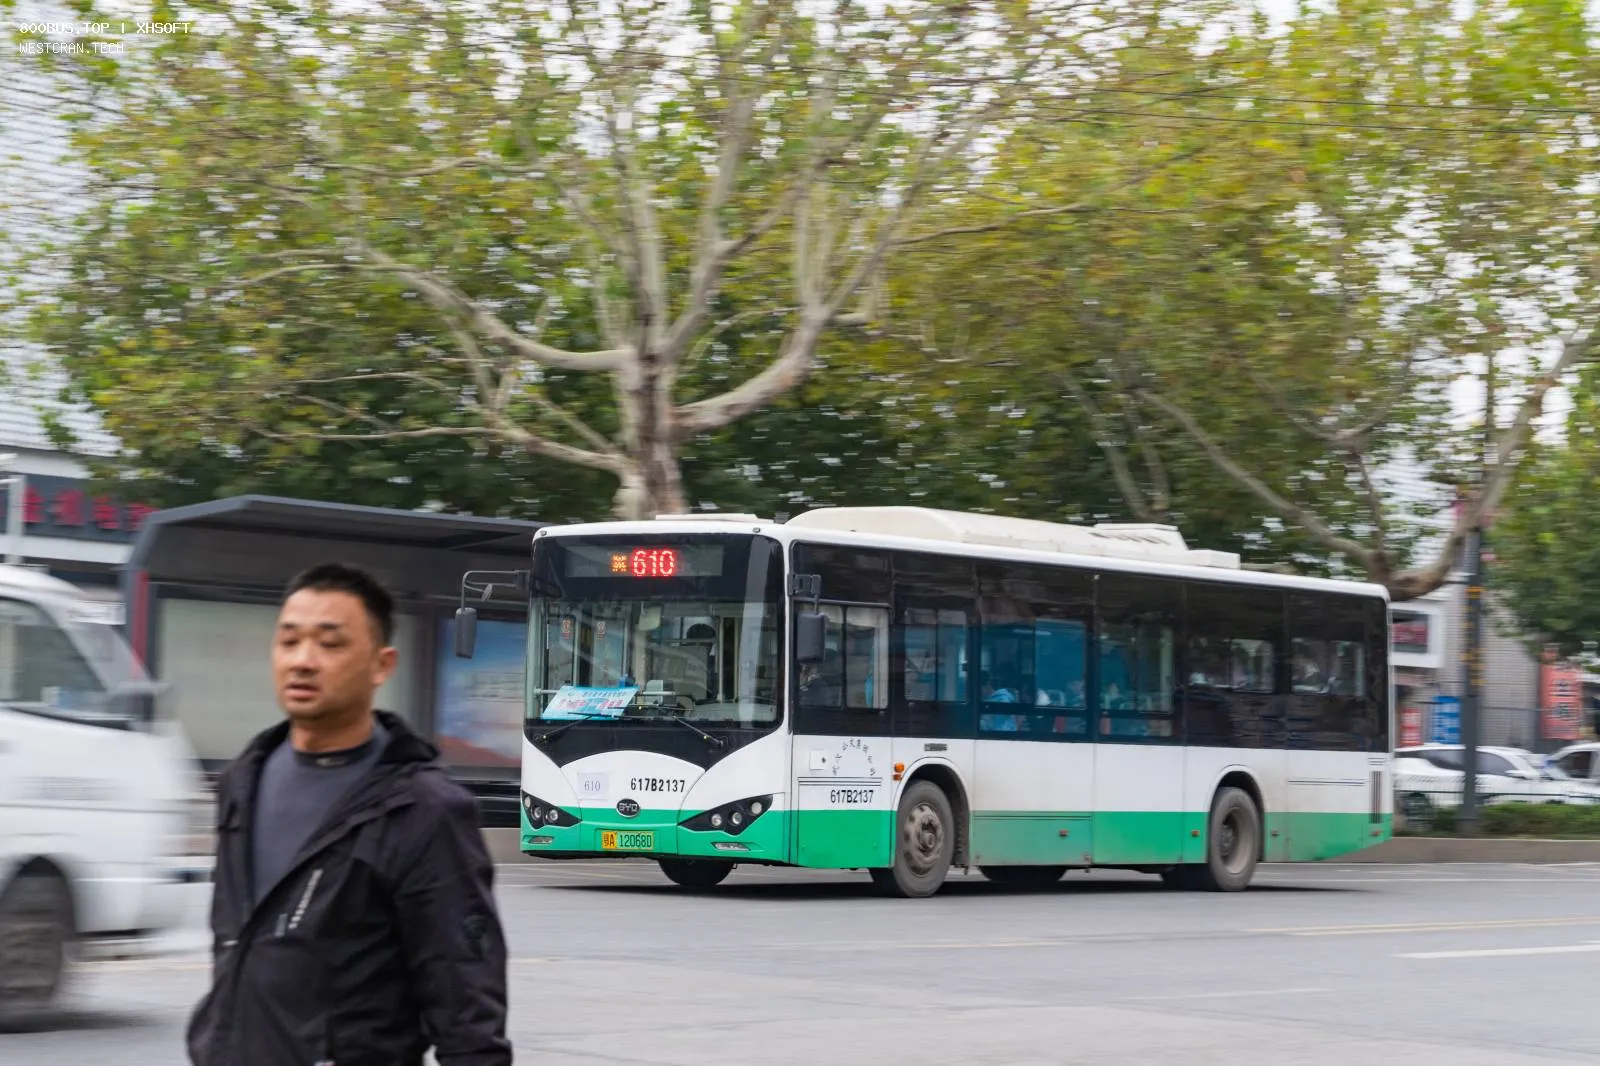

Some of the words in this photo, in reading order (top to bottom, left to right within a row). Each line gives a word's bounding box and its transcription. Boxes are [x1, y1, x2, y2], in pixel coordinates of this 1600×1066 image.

[633, 550, 674, 576] 610
[584, 781, 601, 791] 610
[630, 778, 686, 793] 617B2137
[830, 789, 874, 804] 617B2137
